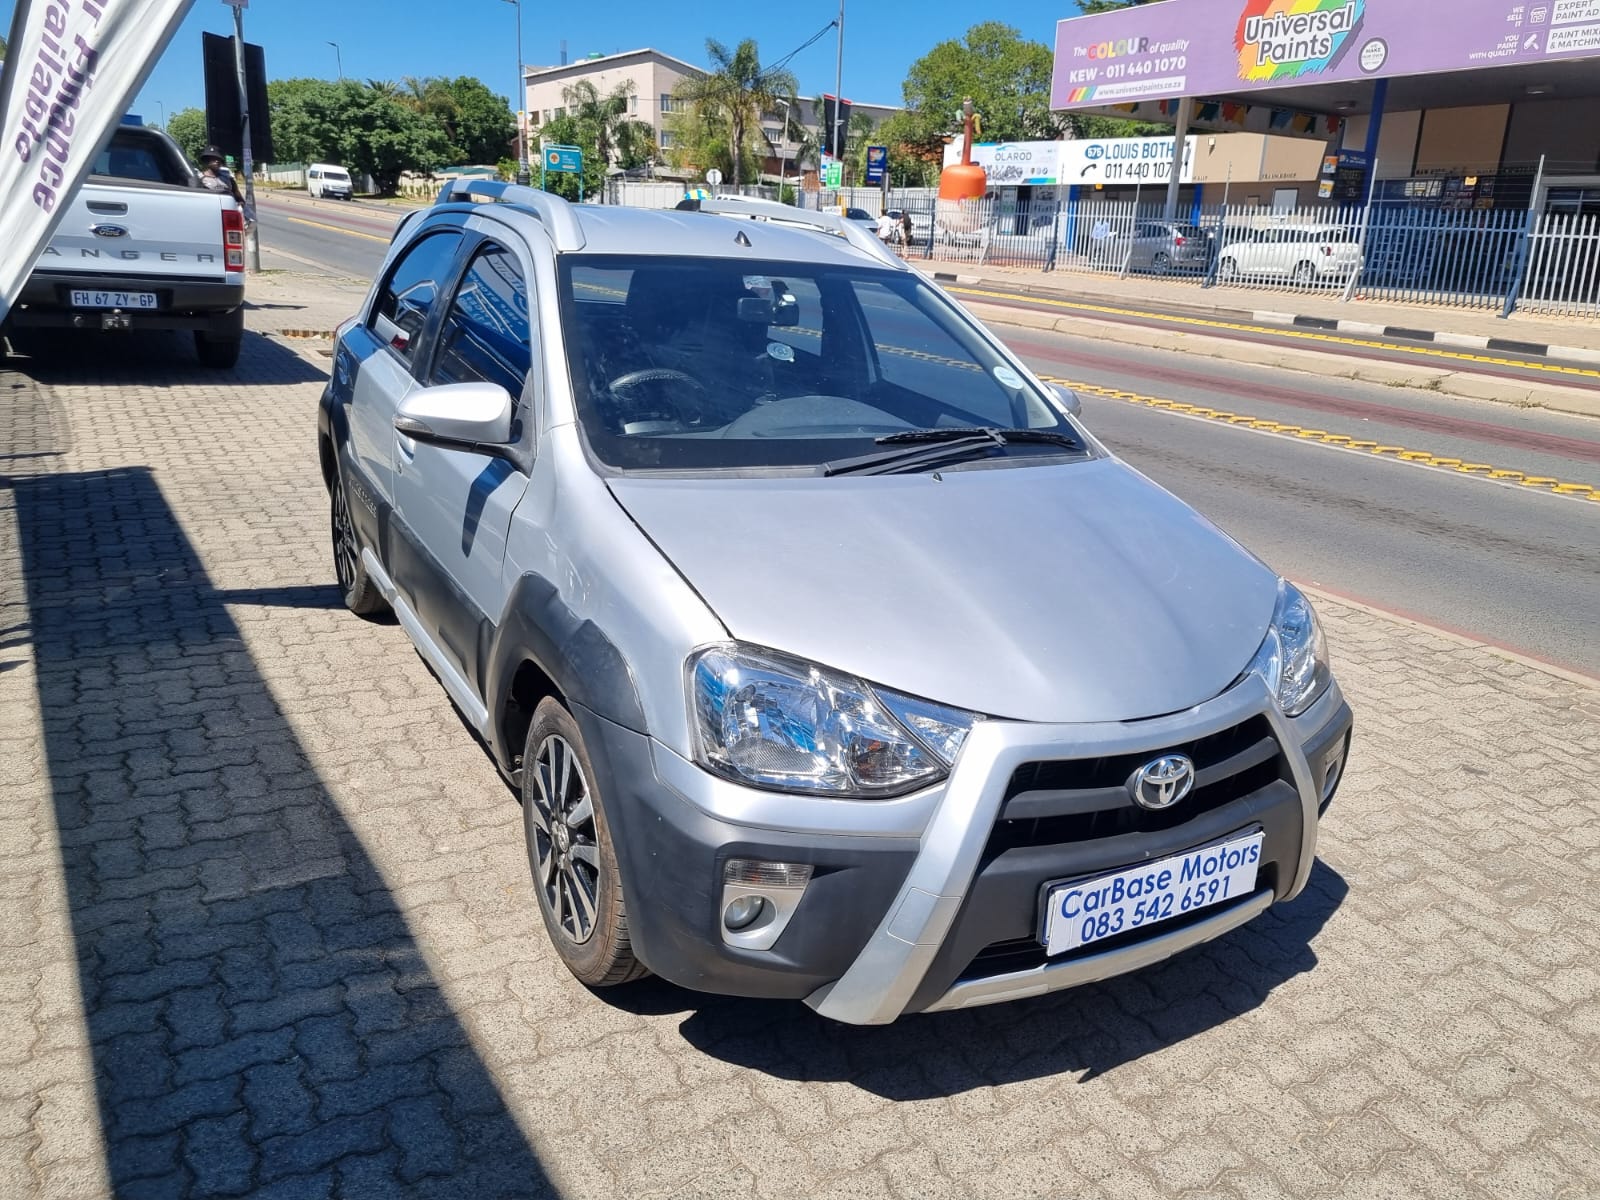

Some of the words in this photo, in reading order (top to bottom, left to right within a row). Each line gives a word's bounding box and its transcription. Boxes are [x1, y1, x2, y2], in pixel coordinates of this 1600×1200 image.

[1557, 0, 1594, 11] EXPERT
[1246, 4, 1353, 41] Universal
[1506, 13, 1522, 22] SELL
[1555, 10, 1583, 20] PAINT
[1504, 34, 1520, 43] YOU
[1551, 30, 1580, 40] PAINT
[1581, 28, 1600, 37] MIX
[1073, 46, 1087, 57] The
[1087, 36, 1149, 60] COLOUR
[1149, 41, 1160, 54] of
[1159, 39, 1190, 54] quality
[1259, 34, 1330, 63] Paints
[1496, 41, 1518, 51] PAINT
[1469, 52, 1487, 61] WITH
[1487, 48, 1517, 59] QUALITY
[1069, 67, 1098, 83] KEW
[1106, 63, 1125, 78] 011
[1127, 60, 1152, 75] 440
[1154, 56, 1186, 72] 1070
[33, 33, 98, 214] Finance
[1105, 143, 1139, 160] LOUIS
[1142, 141, 1175, 159] BOTH
[1105, 163, 1123, 178] 011
[1126, 163, 1150, 178] 440
[42, 245, 215, 263] ANGER
[74, 292, 90, 305] FH
[95, 293, 109, 305] 67
[114, 294, 129, 306] ZY
[139, 294, 154, 307] GP
[1061, 868, 1172, 919] CarBase
[1179, 843, 1259, 884] Motors
[1081, 907, 1124, 942] 083
[1131, 893, 1174, 926] 542
[1180, 875, 1231, 911] 6591
